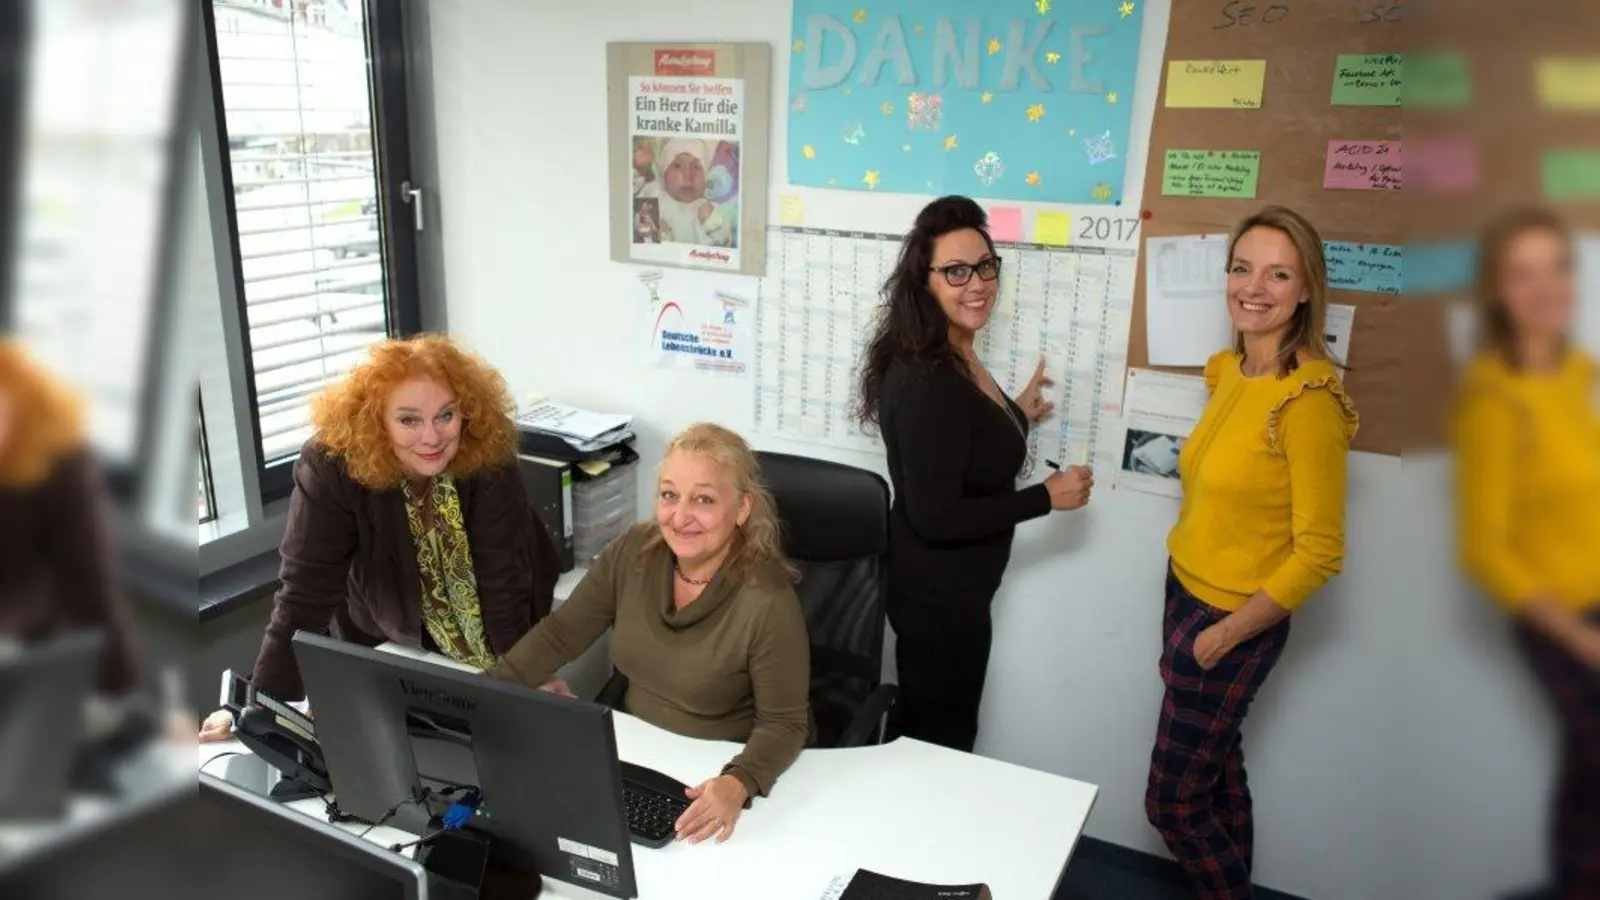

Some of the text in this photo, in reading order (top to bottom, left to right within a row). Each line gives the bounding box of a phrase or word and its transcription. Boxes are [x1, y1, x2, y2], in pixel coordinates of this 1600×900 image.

[1212, 0, 1289, 30] SEO
[803, 13, 1110, 95] DANKE
[639, 81, 733, 96] So können Sie helfen
[635, 95, 738, 115] Ein Herz für die
[636, 115, 737, 135] kranke Kamilla
[1079, 215, 1139, 241] 2017
[661, 329, 699, 343] Deutsche
